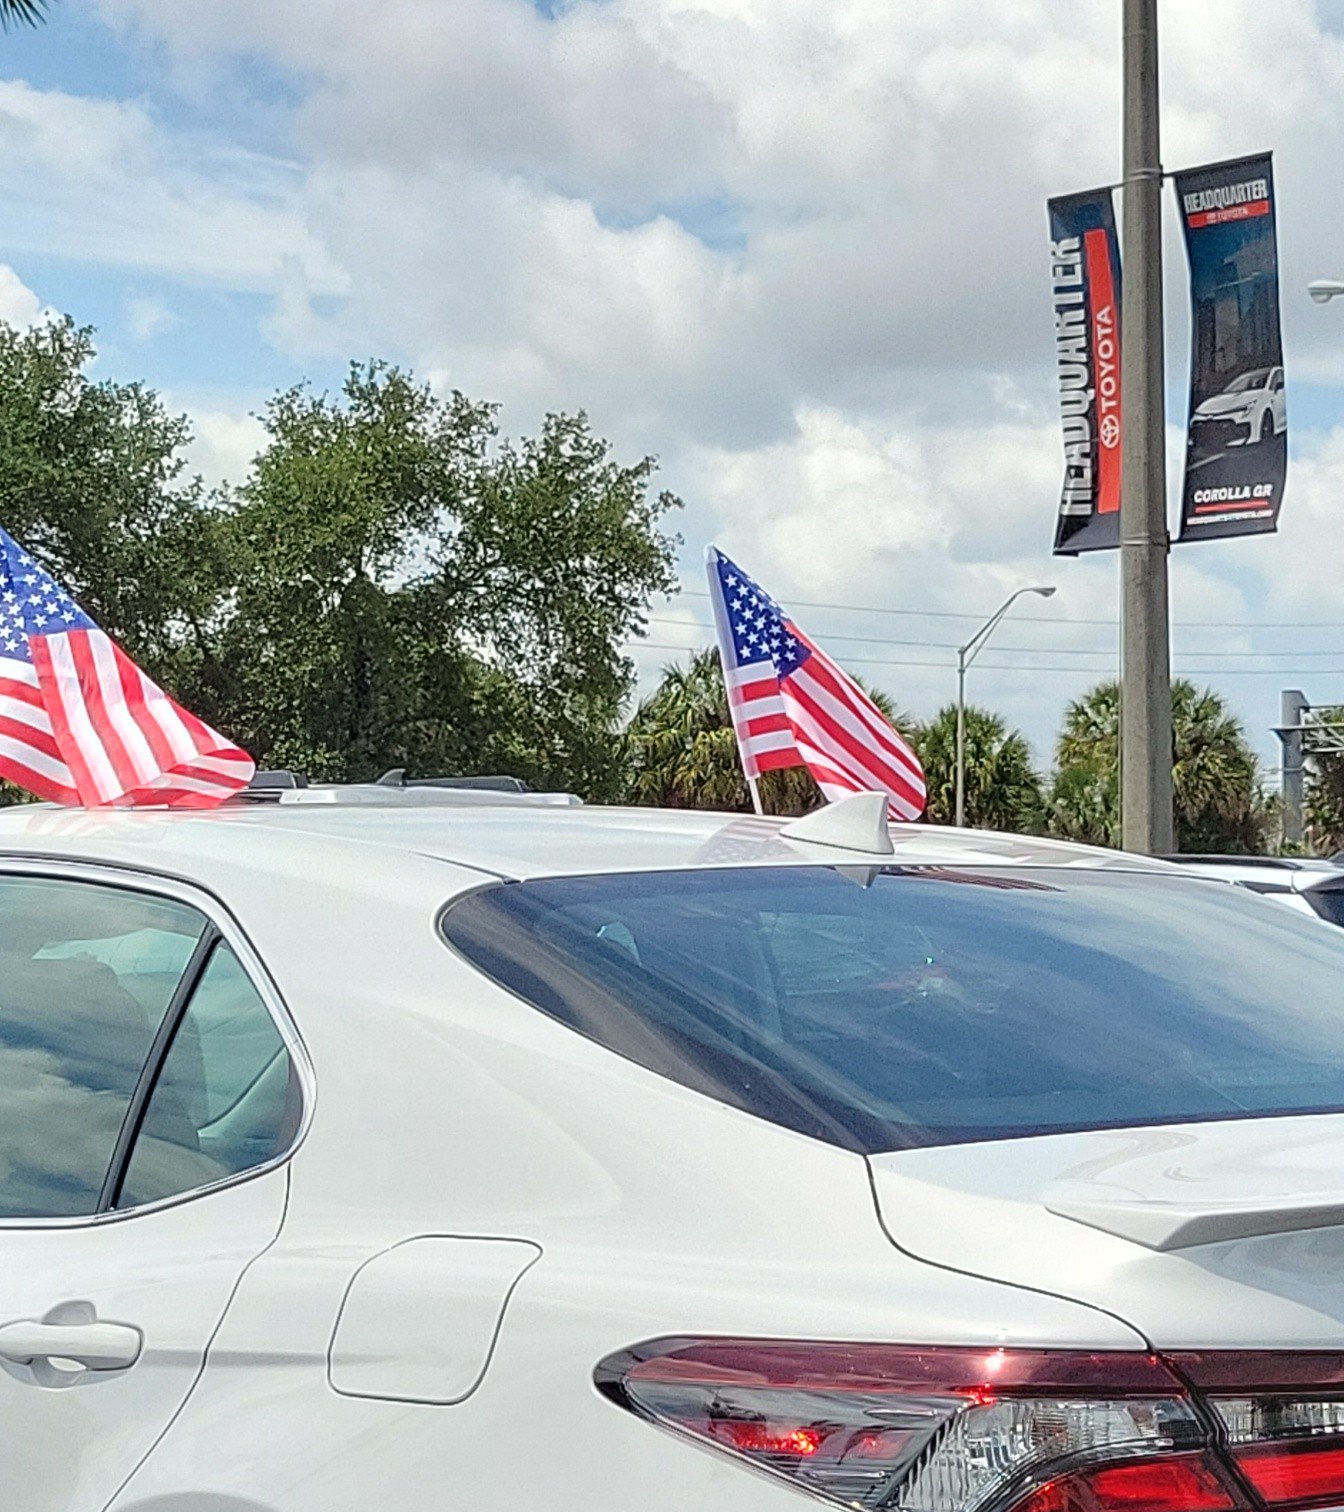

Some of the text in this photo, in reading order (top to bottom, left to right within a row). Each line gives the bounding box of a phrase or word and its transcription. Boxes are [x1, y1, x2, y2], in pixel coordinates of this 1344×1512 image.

[1183, 178, 1269, 214] HEADQUARTER
[1052, 236, 1095, 516] HEADQUARTER
[1097, 304, 1118, 413] TOYOTA
[1193, 483, 1273, 503] COROLLA GR
